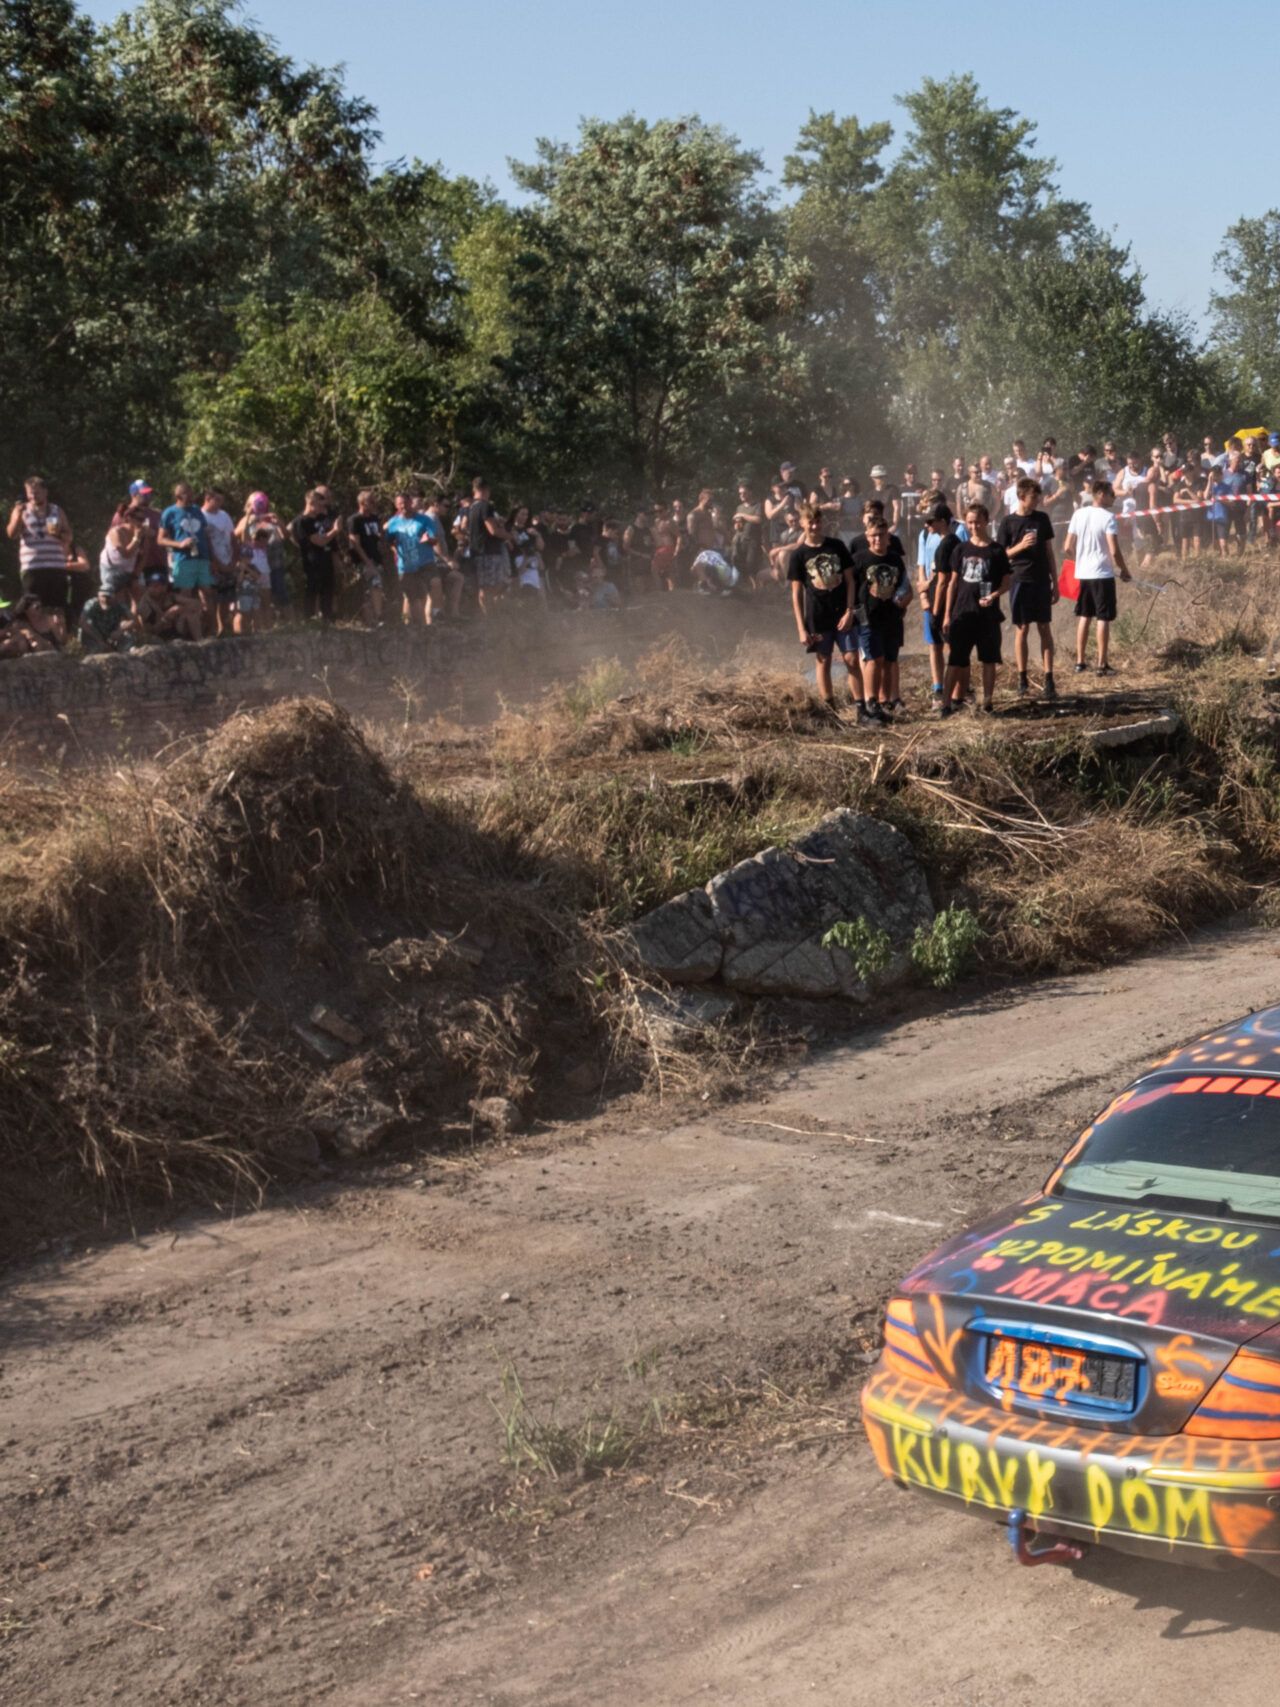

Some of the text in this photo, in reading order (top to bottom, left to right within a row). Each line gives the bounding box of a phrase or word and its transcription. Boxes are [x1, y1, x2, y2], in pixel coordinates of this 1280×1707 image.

[1013, 1203, 1259, 1249] S LÁSKOU
[1086, 1464, 1217, 1549] DOM
